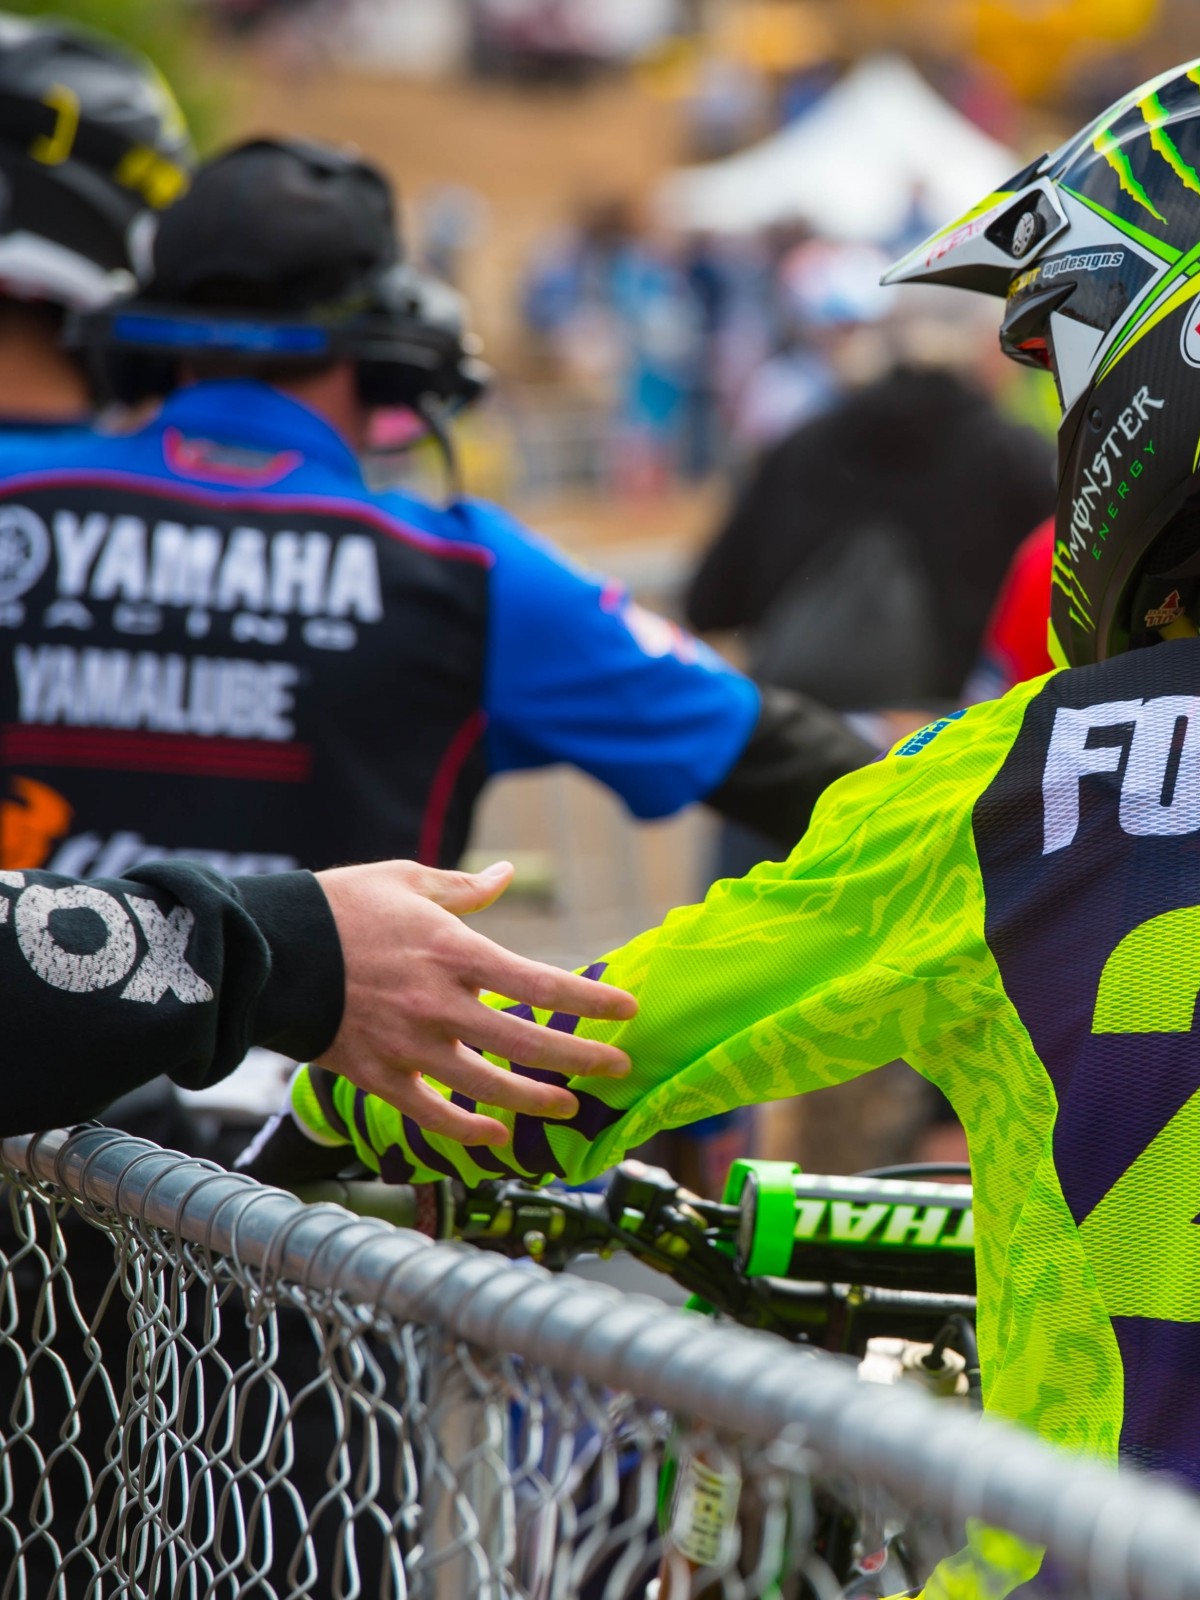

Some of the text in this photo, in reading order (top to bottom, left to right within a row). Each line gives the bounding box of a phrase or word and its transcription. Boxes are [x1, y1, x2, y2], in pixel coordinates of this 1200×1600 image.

[1042, 252, 1125, 279] apdesigns
[1091, 440, 1156, 560] ENERGY
[53, 509, 385, 624] YAMAHA
[14, 643, 301, 741] YAMALUBE
